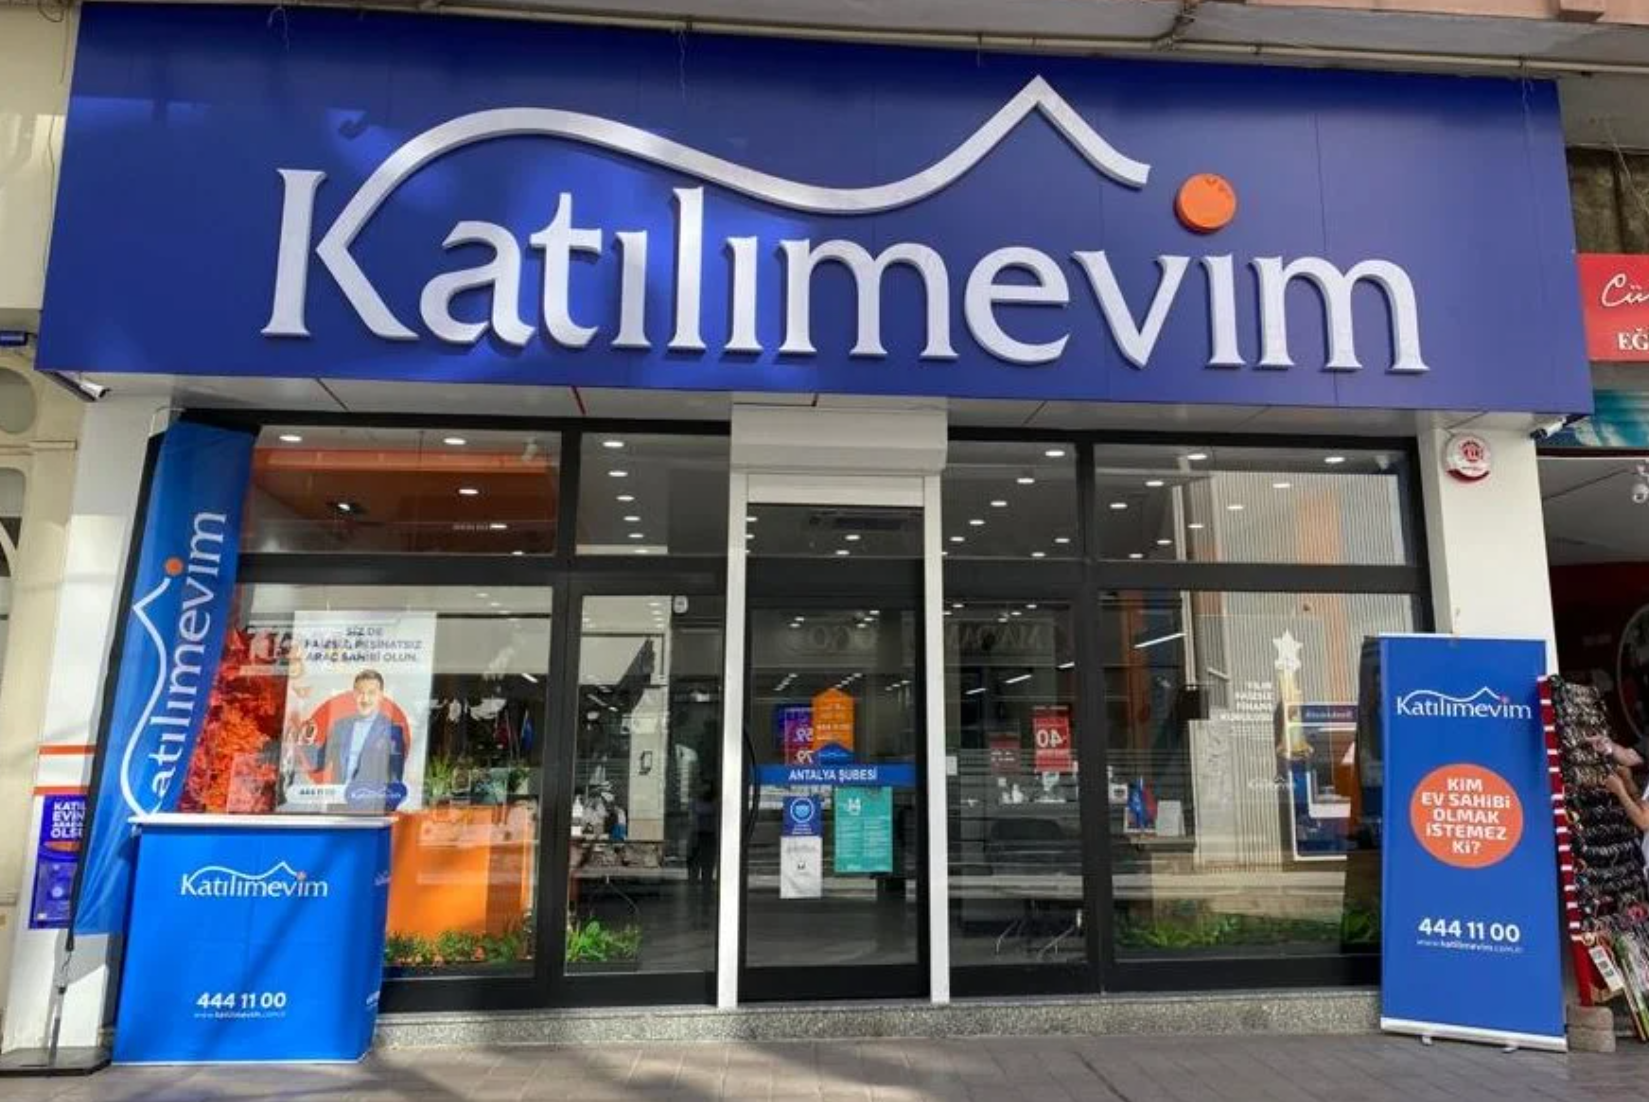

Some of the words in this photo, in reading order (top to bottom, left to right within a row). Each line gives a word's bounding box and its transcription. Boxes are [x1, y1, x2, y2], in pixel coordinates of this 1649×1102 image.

[1397, 686, 1532, 719] Katılımevim
[788, 769, 837, 781] ANTALYA
[838, 767, 878, 784] ŞUBESİ
[1421, 792, 1444, 806] EV
[1433, 808, 1500, 825] OLMAK
[180, 861, 328, 898] Katılımevim
[1418, 918, 1461, 938] 444
[1467, 922, 1484, 940] 11
[1490, 922, 1520, 943] 00
[196, 992, 235, 1008] 444
[240, 992, 255, 1008] 11
[260, 992, 286, 1008] 00
